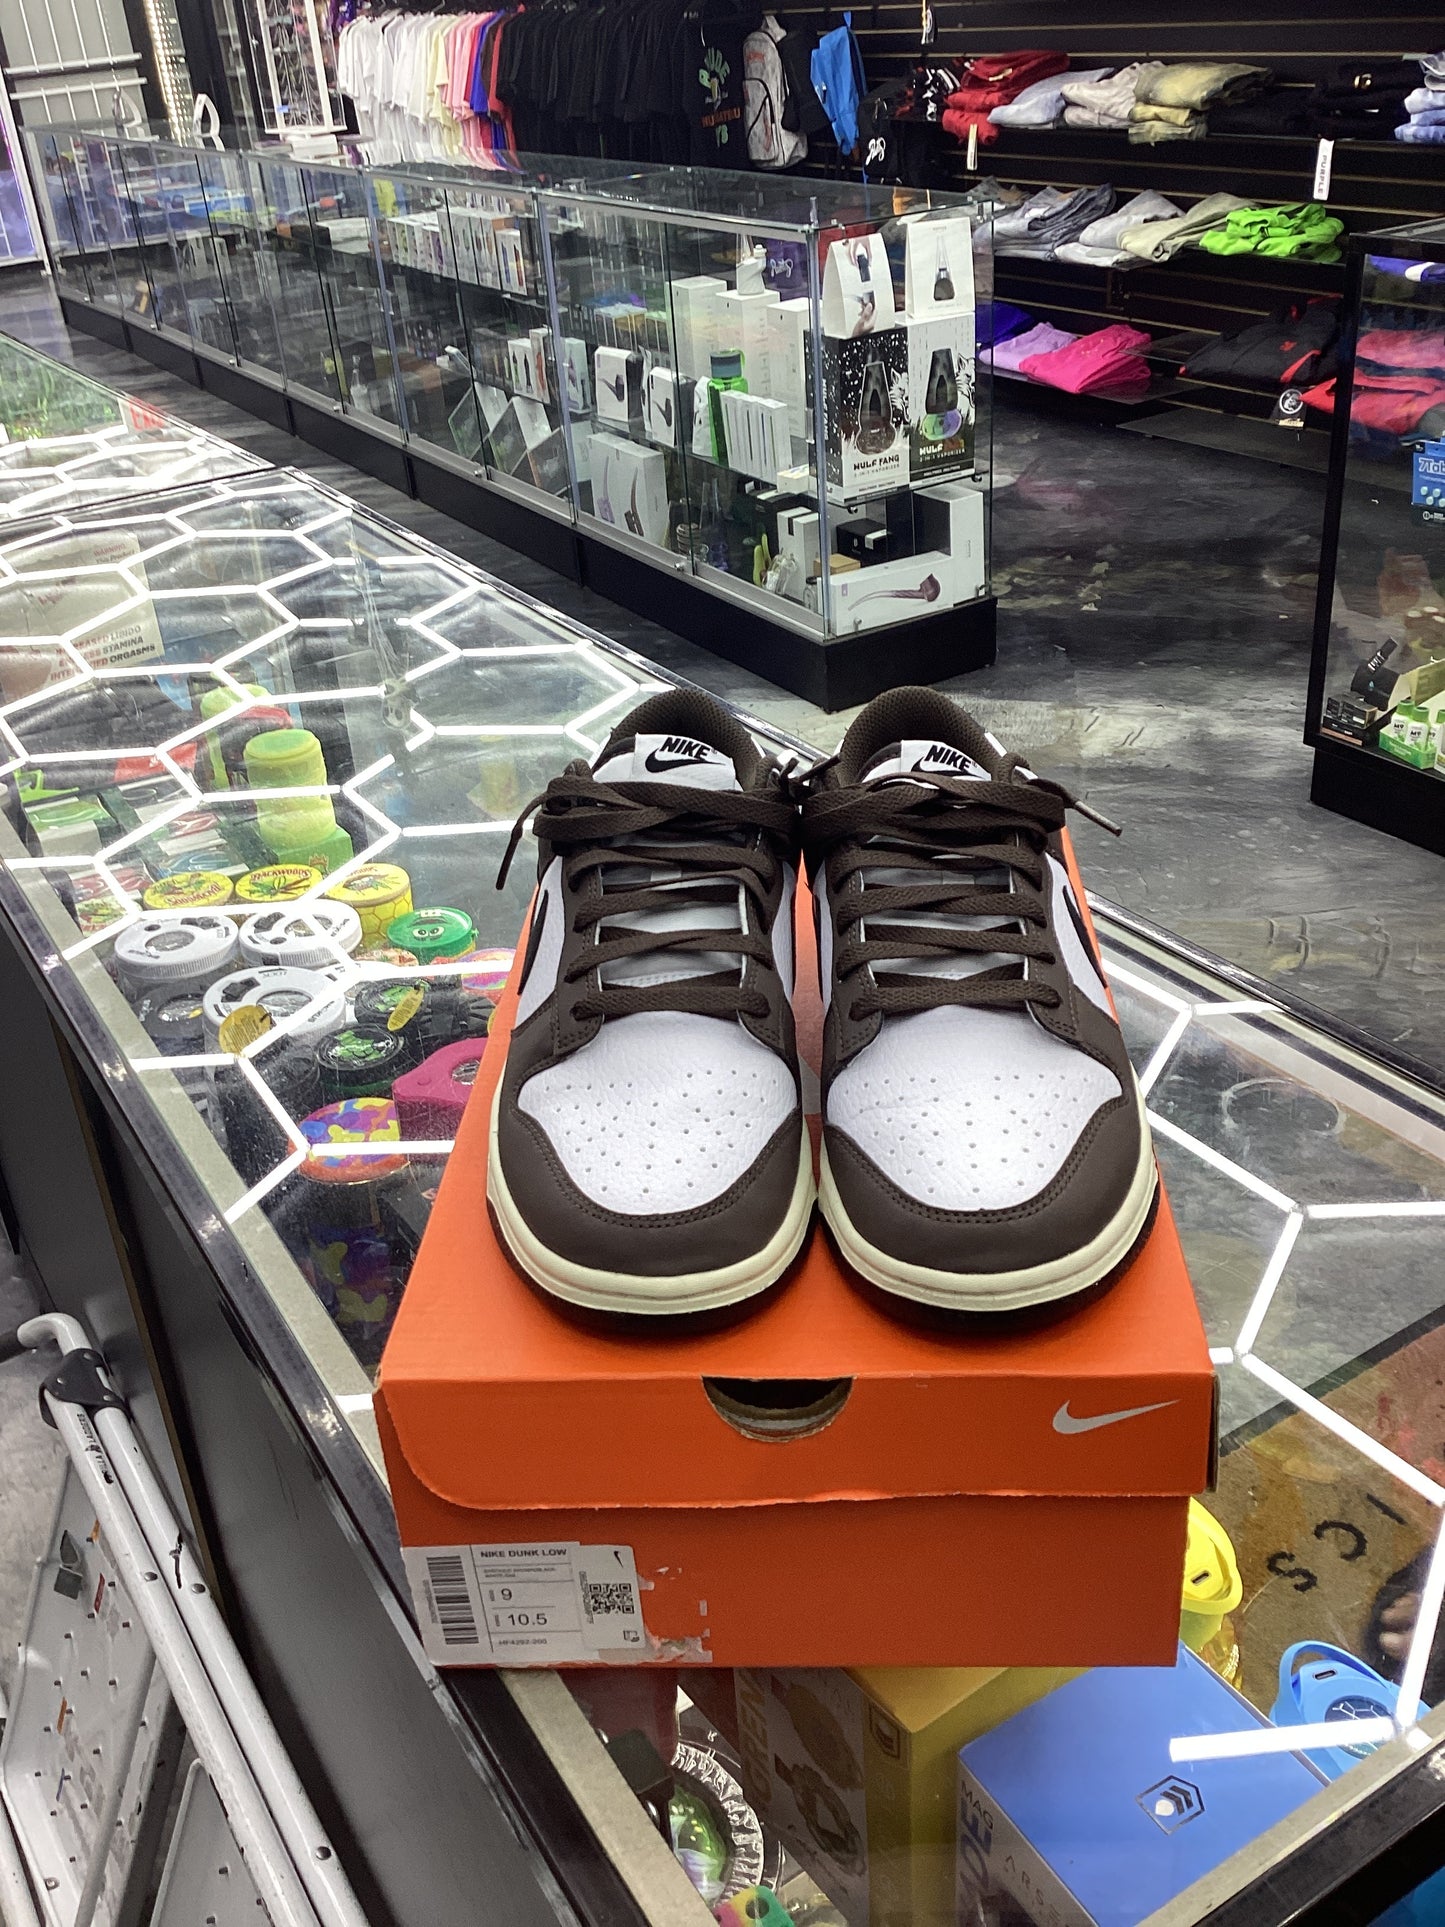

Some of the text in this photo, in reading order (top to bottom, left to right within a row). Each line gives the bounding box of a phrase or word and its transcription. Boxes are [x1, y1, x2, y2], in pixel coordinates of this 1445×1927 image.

[879, 454, 900, 466] FANG
[103, 636, 144, 655] STAMINA
[110, 644, 155, 663] ORGASMS
[660, 737, 710, 760] NIKE
[924, 745, 971, 771] NIKE
[480, 1548, 567, 1558] NIKE DUNK LOW
[501, 1588, 513, 1602] 9
[507, 1613, 548, 1626] 10.5
[961, 1780, 994, 1830] MAG
